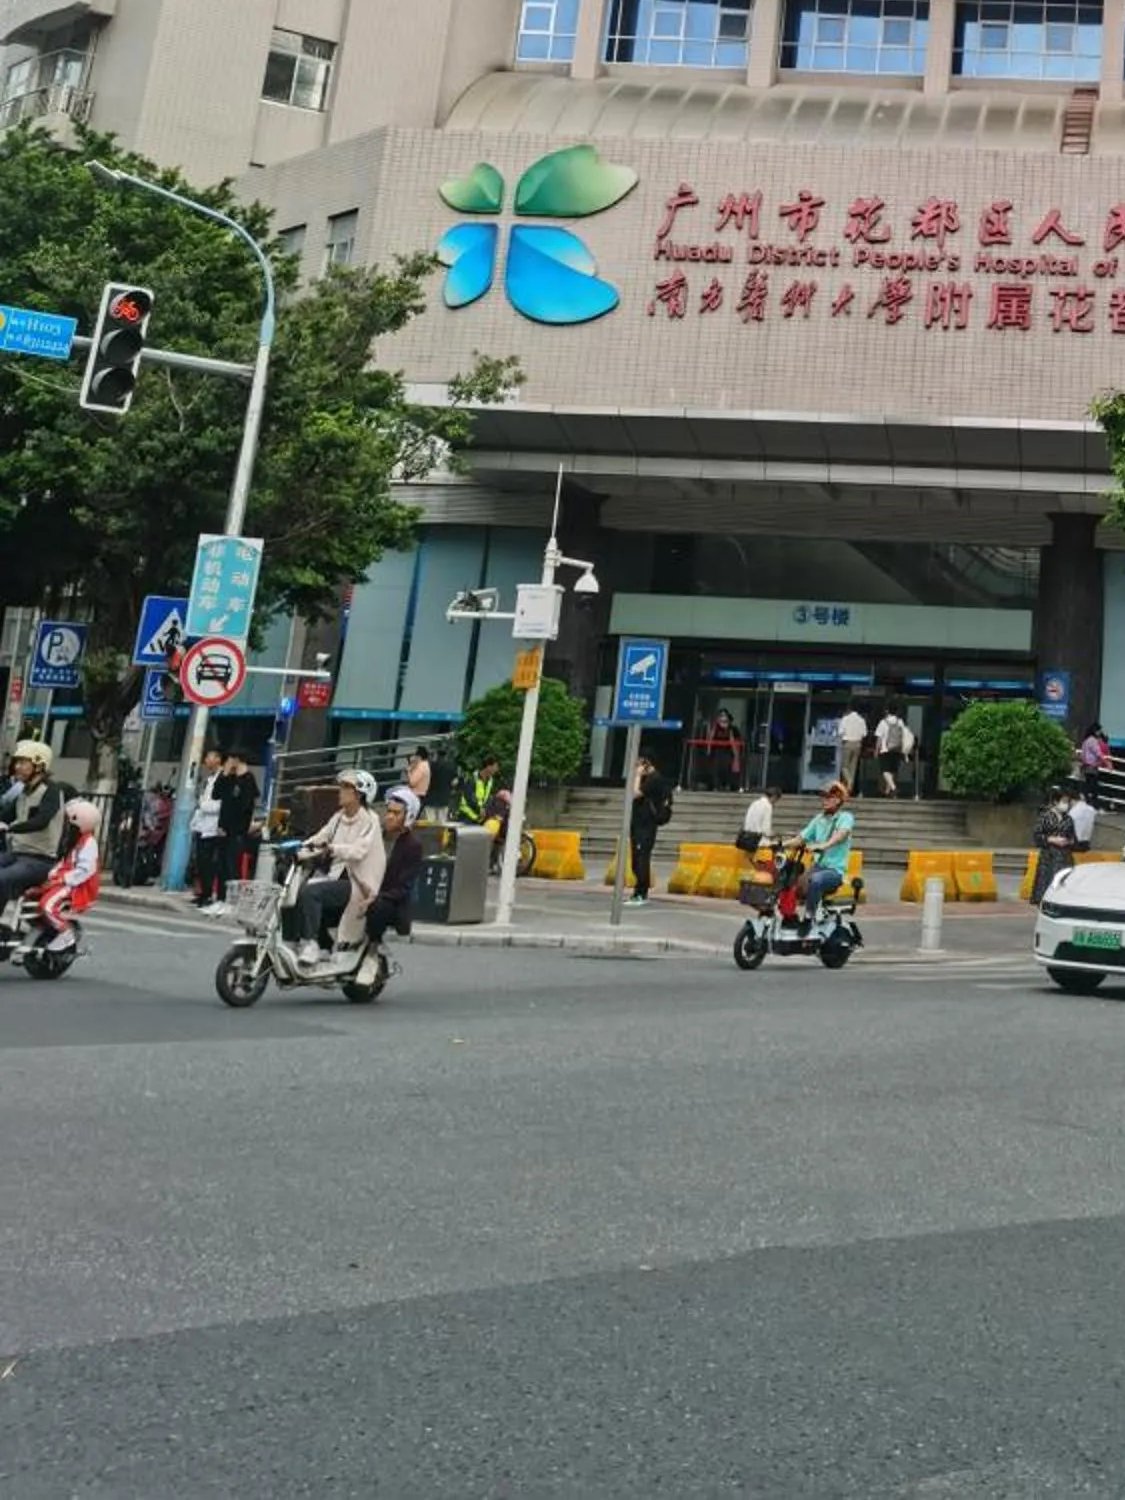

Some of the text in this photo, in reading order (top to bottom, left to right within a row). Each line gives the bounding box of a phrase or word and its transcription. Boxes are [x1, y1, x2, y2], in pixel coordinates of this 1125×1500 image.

[654, 238, 733, 264] Huadu
[748, 243, 841, 268] District
[852, 248, 960, 274] People's
[973, 253, 1079, 279] Hospital
[1093, 257, 1120, 279] of
[47, 631, 64, 661] P
